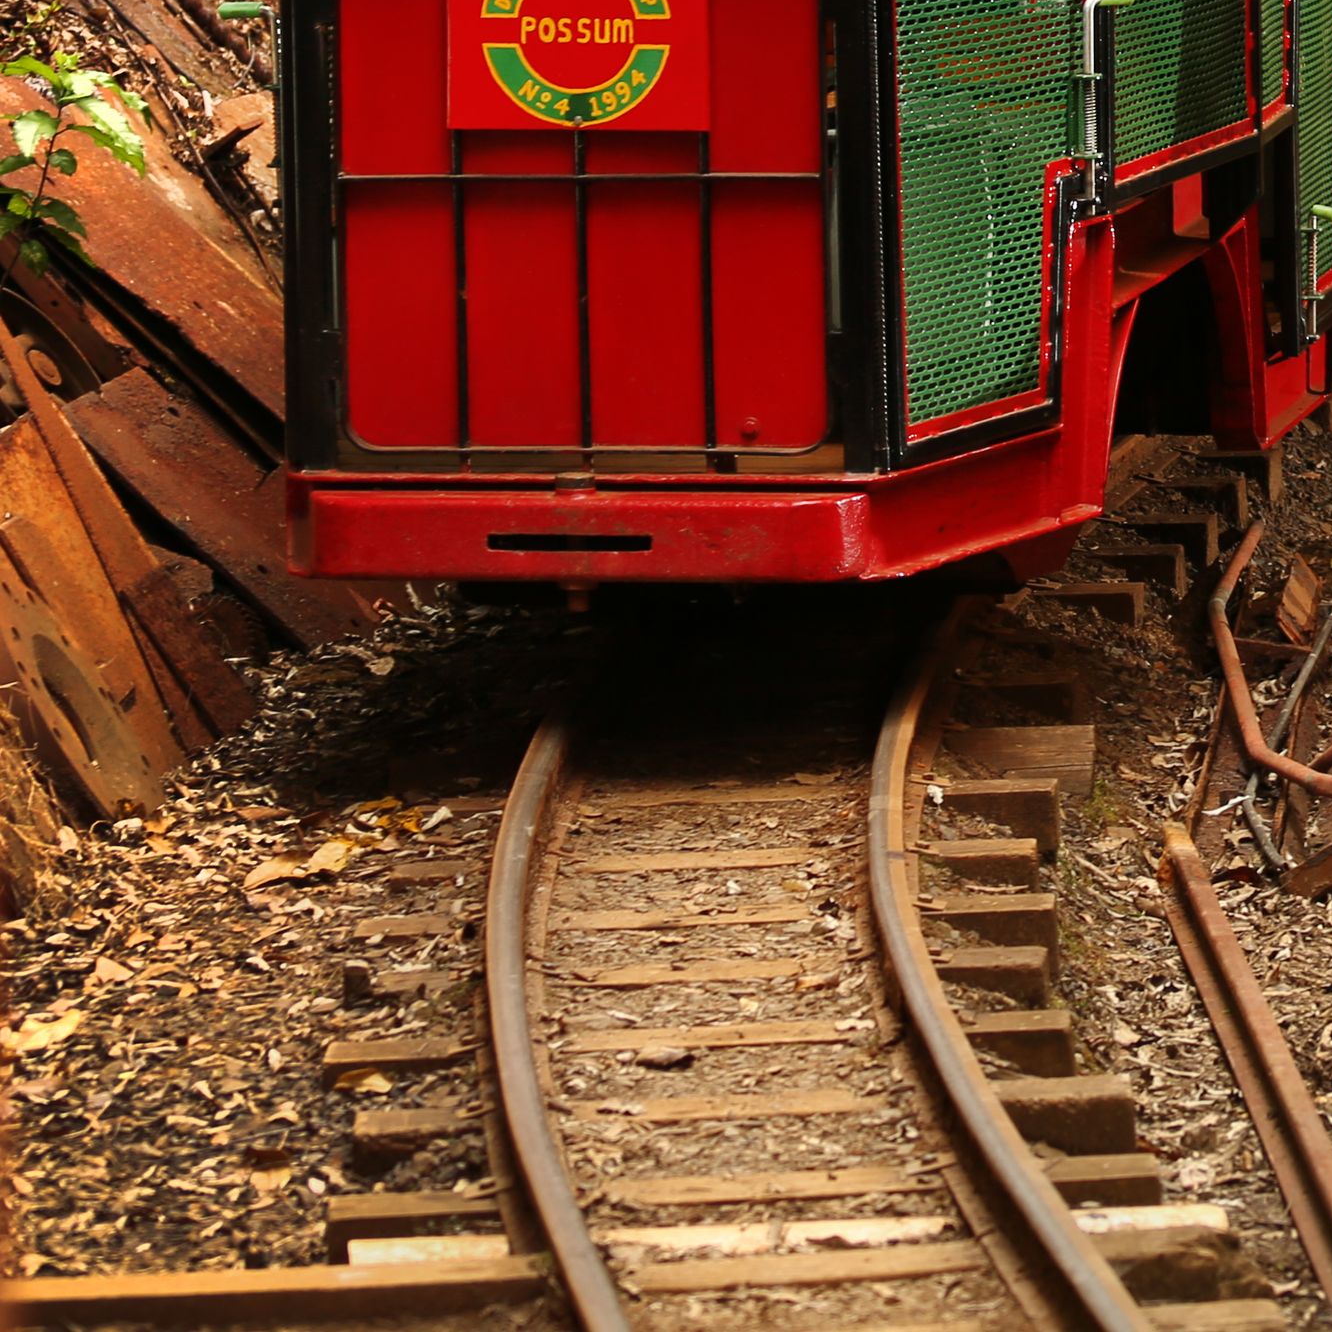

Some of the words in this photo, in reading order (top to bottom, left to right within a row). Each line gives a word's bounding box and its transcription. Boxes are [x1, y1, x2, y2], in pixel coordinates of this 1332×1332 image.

[521, 16, 635, 44] POSSUM
[553, 98, 570, 115] 4
[589, 69, 647, 116] 1994
